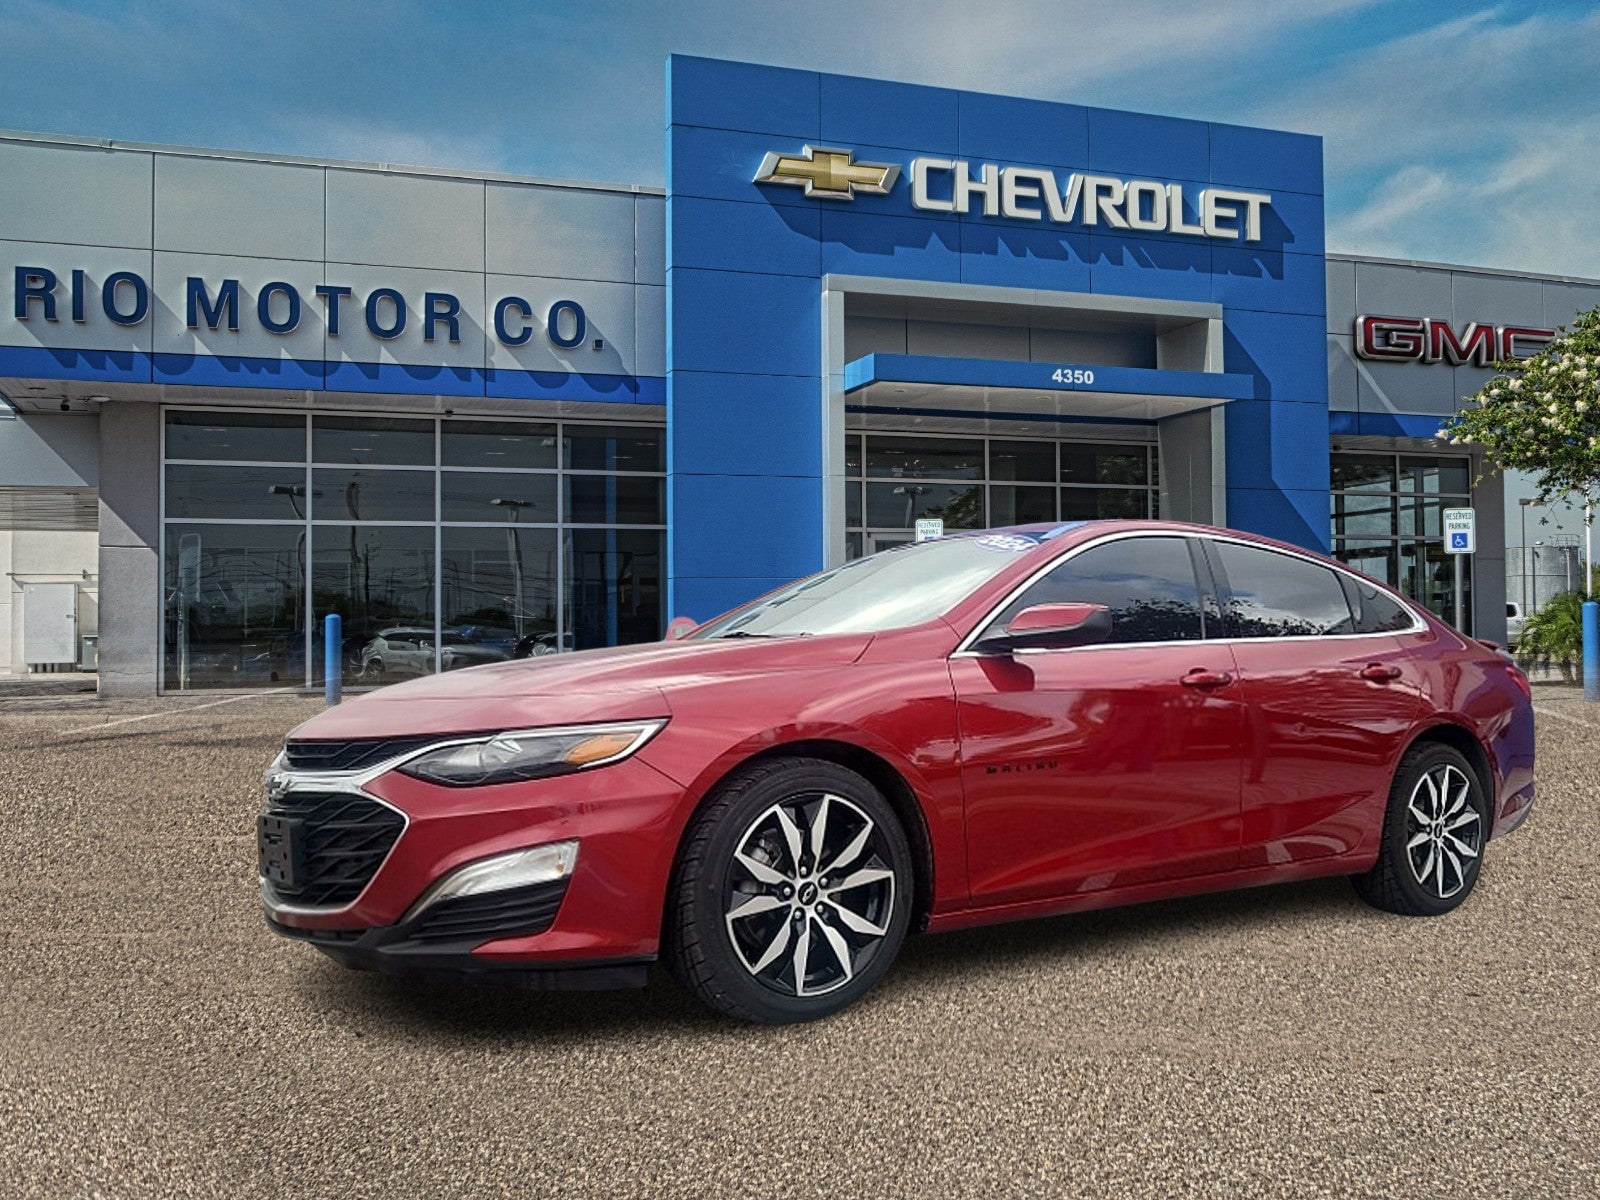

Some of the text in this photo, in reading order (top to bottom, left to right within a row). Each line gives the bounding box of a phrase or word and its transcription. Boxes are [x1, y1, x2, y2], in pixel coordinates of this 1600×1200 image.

[910, 157, 1272, 242] CHEVROLET
[14, 265, 604, 350] RIO MOTOR CO.
[1355, 313, 1557, 368] GMC
[1052, 368, 1095, 385] 4350
[1445, 512, 1472, 520] RESERVED
[985, 761, 1058, 775] MALIBU
